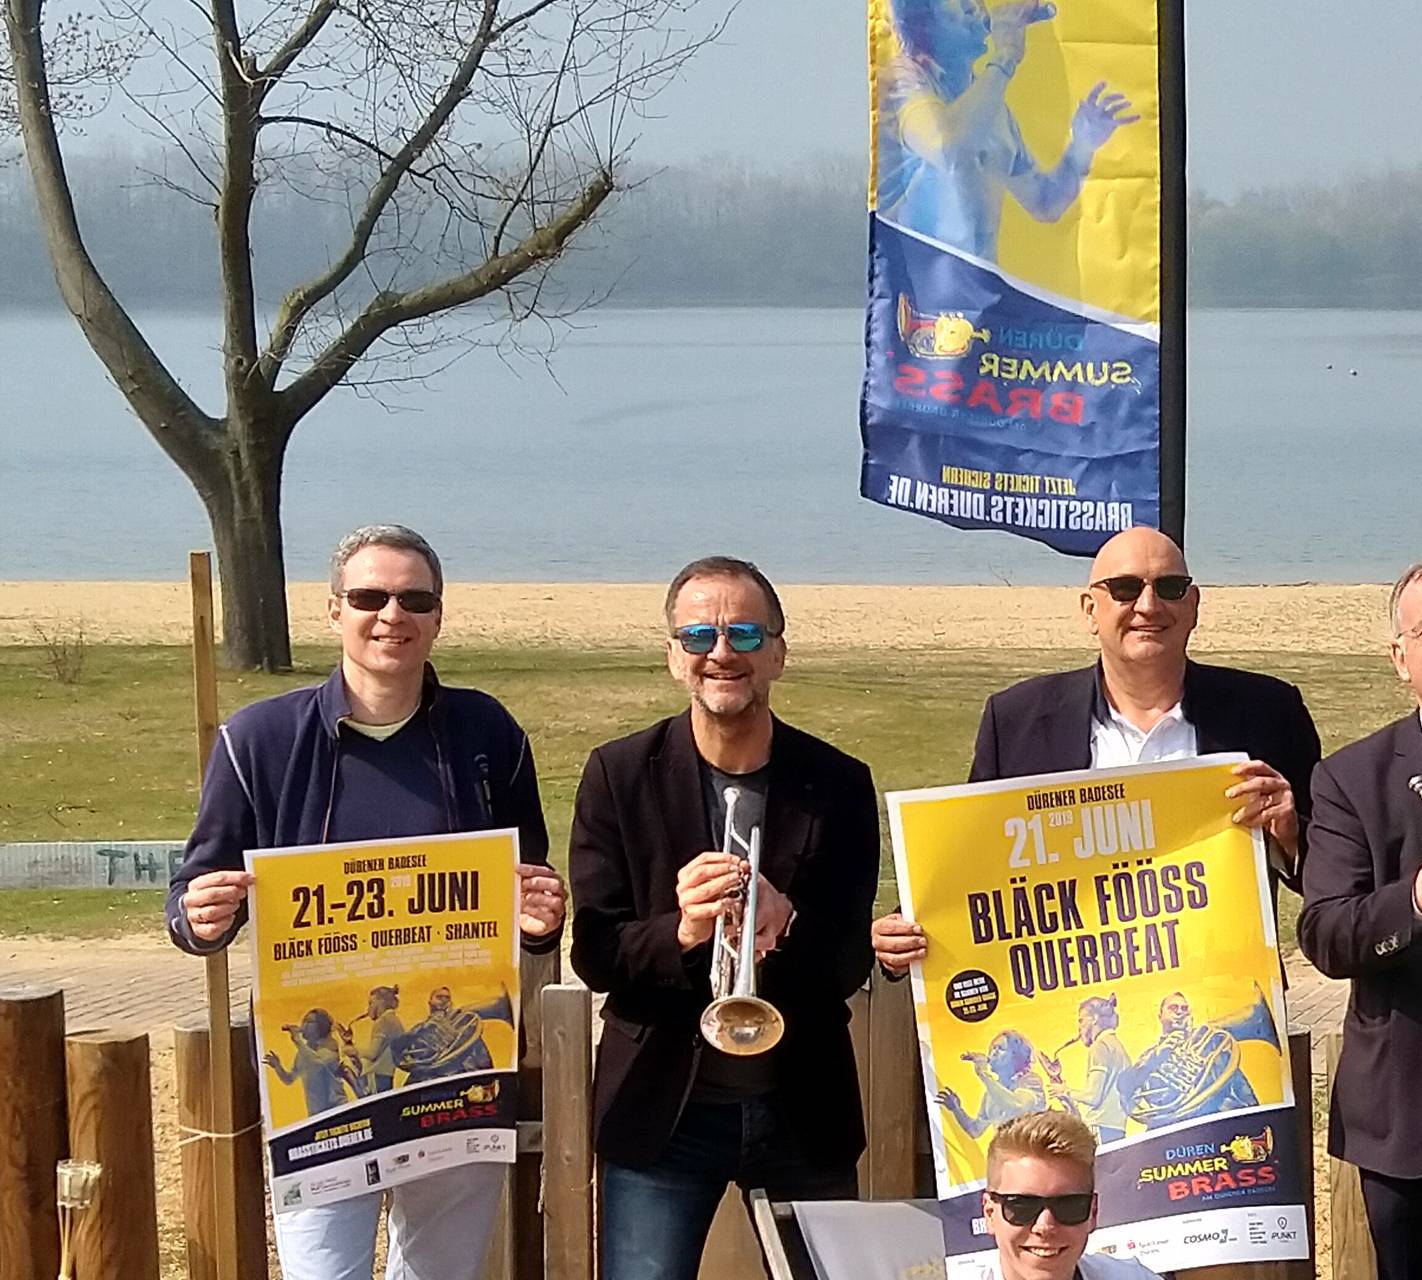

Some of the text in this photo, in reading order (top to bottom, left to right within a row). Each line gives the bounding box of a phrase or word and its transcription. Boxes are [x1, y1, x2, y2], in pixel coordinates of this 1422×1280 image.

[1027, 783, 1126, 811] DÜRENER BADESEE
[1004, 814, 1060, 869] 21.
[1073, 799, 1156, 859] JUNI
[407, 870, 480, 915] JUNI
[967, 857, 1209, 946] BLÄCK FÖÖSS
[273, 937, 313, 961] BLÄCK
[371, 925, 433, 949] QUERBEAT
[445, 921, 499, 941] SHANTEL
[1008, 918, 1181, 999] QUERBEAT
[401, 1098, 465, 1117] SUMMER
[1138, 1156, 1230, 1184] SUMMER
[1165, 1143, 1216, 1161] DÜREN
[1167, 1165, 1277, 1201] BRASS
